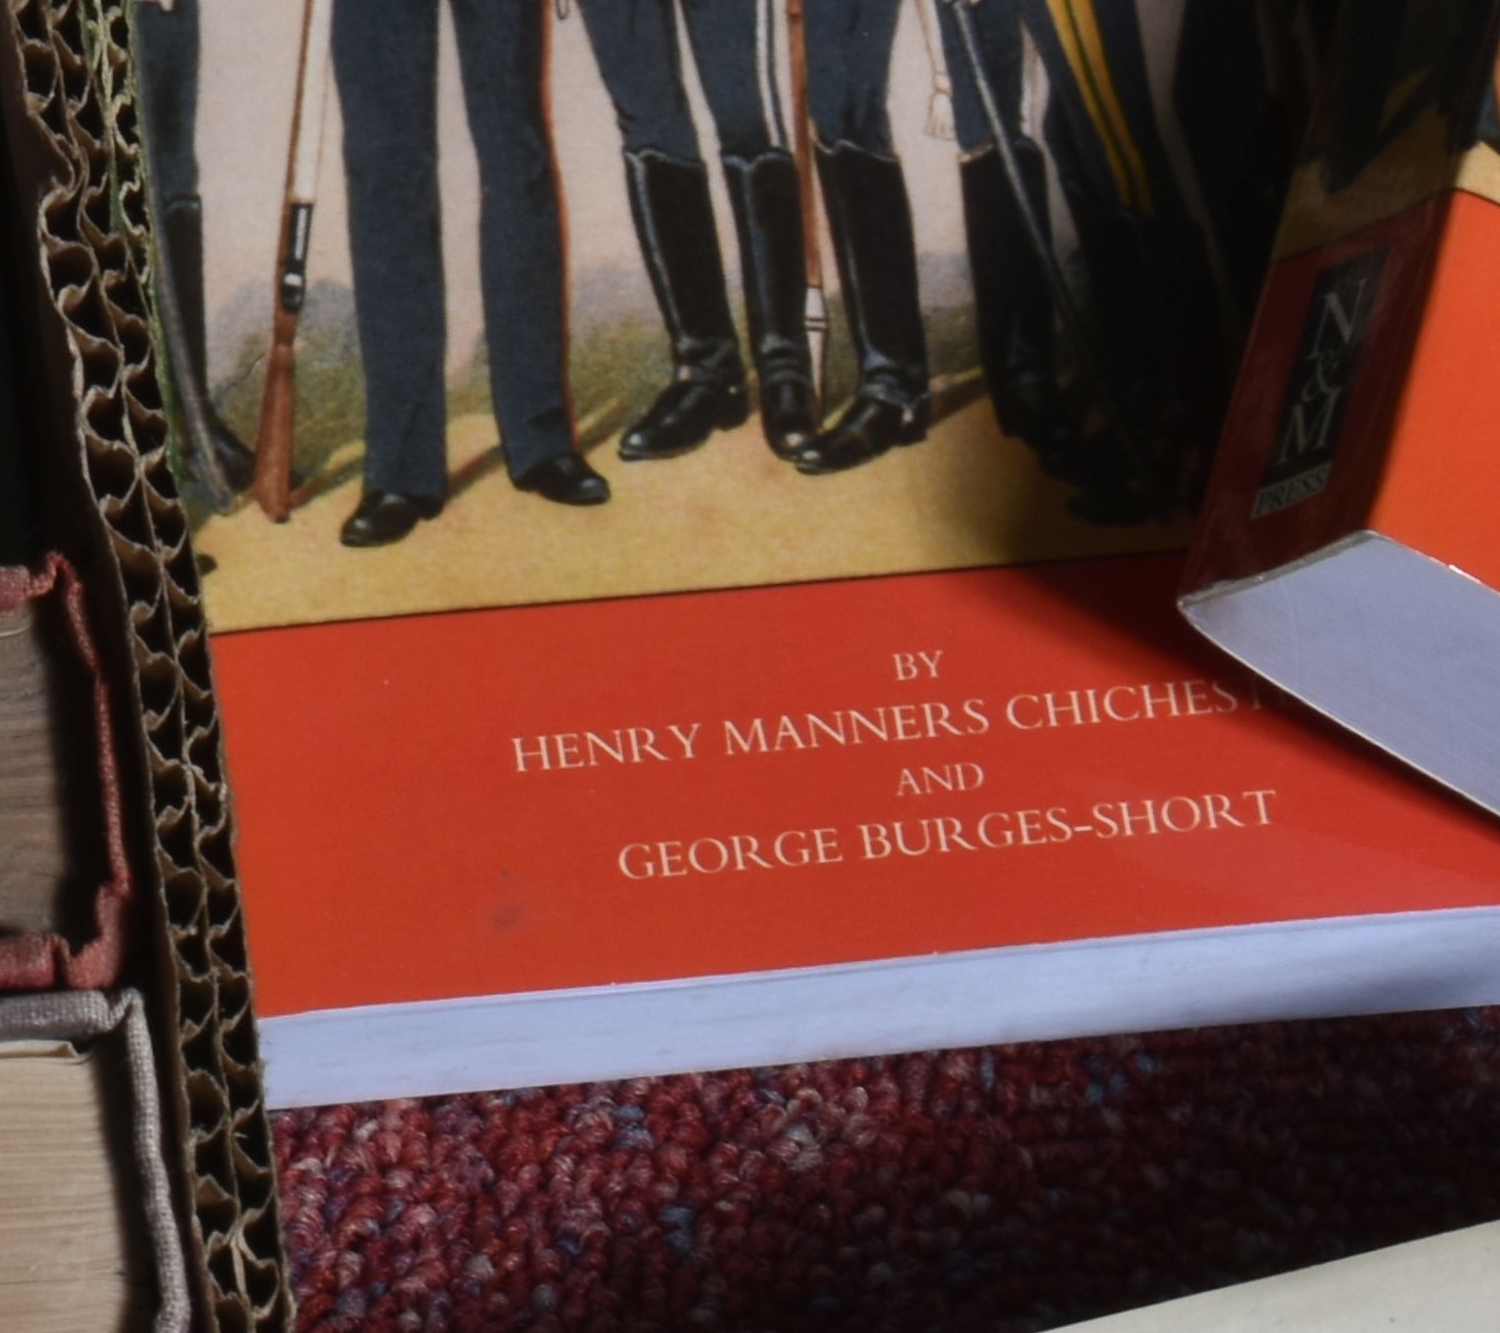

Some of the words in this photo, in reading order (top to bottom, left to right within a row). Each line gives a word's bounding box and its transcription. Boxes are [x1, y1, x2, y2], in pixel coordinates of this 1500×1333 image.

[1306, 275, 1369, 361] N
[1276, 386, 1344, 466] M
[891, 649, 944, 682] BY
[510, 722, 702, 774] HENRY
[722, 698, 991, 758] MANNERS
[895, 761, 986, 798] AND
[616, 827, 845, 882] GEORGE
[858, 789, 1280, 862] BURGES-SHORT
